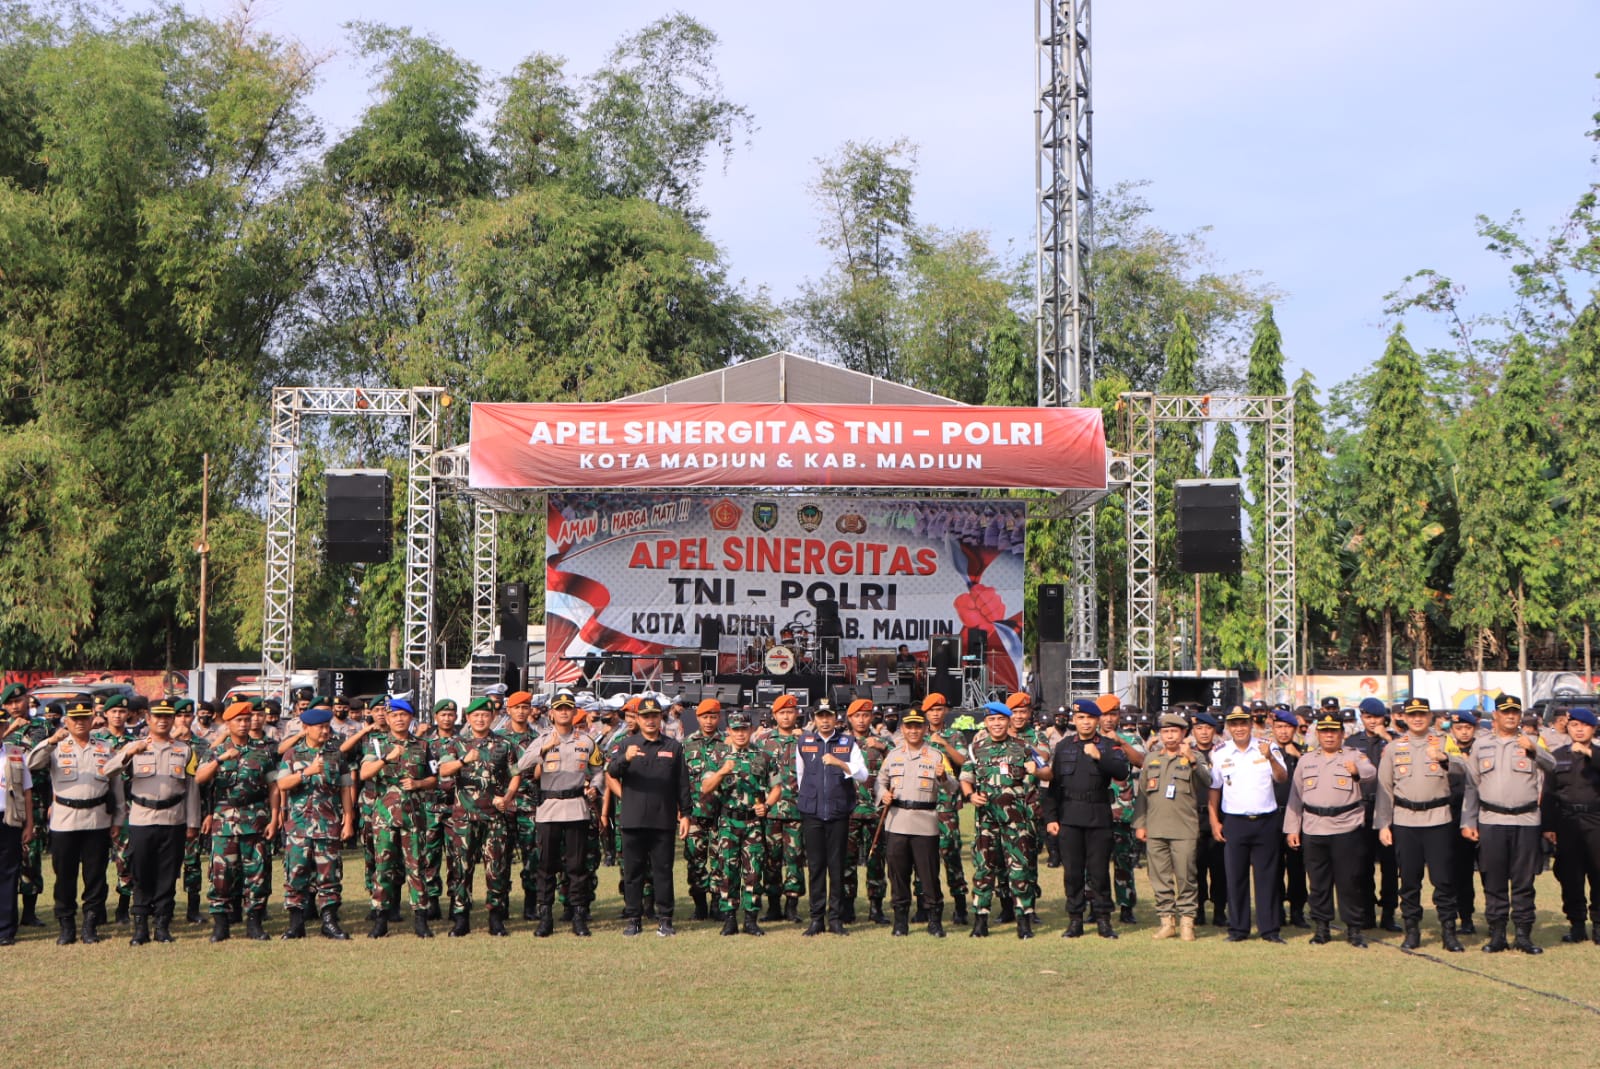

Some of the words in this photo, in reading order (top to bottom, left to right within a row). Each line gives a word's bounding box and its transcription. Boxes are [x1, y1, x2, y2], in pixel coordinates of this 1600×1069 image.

[529, 421, 614, 445] APEL
[623, 420, 835, 445] SINERGITAS
[844, 421, 902, 444] TNI
[942, 421, 1043, 445] POLRI
[580, 453, 650, 469] KOTA
[660, 453, 766, 469] MADIUN
[776, 453, 793, 468] &
[804, 453, 866, 468] KAB.
[877, 453, 982, 469] MADIUN
[559, 516, 598, 541] AMAN
[612, 508, 647, 531] HARGA
[652, 503, 676, 523] MATI
[628, 537, 716, 570] APEL
[722, 535, 937, 576] SINERGITAS
[668, 578, 735, 606] TNI
[780, 580, 897, 611] POLRI
[631, 612, 686, 634] KOTA
[873, 618, 953, 640] MADIUN
